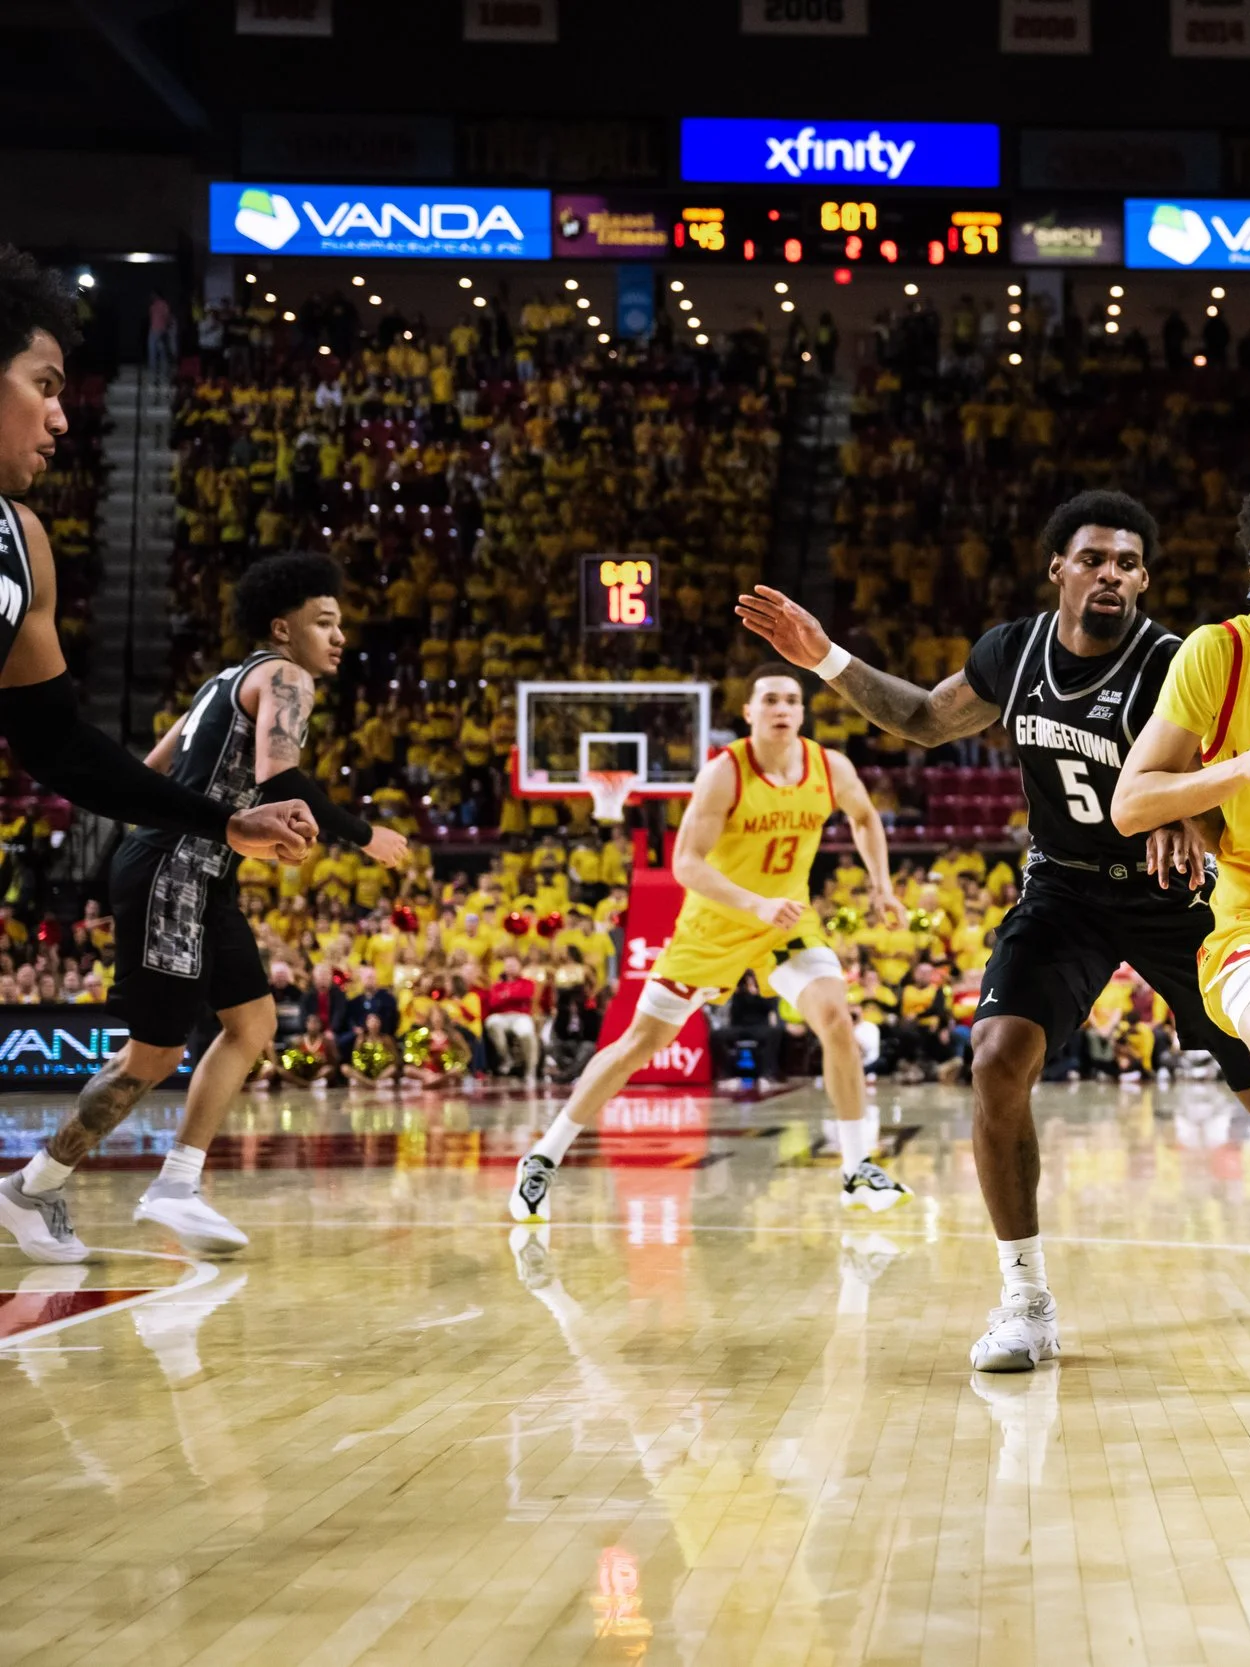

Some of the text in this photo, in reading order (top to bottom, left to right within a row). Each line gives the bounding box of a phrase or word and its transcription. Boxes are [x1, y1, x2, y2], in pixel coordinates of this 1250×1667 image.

[764, 125, 917, 180] xfinity
[301, 200, 525, 240] VANDA
[689, 222, 725, 251] 45
[962, 225, 998, 254] 57
[608, 584, 646, 624] 16
[1016, 715, 1122, 769] GEORGETOWN
[1055, 759, 1104, 824] 5
[761, 835, 799, 876] 13
